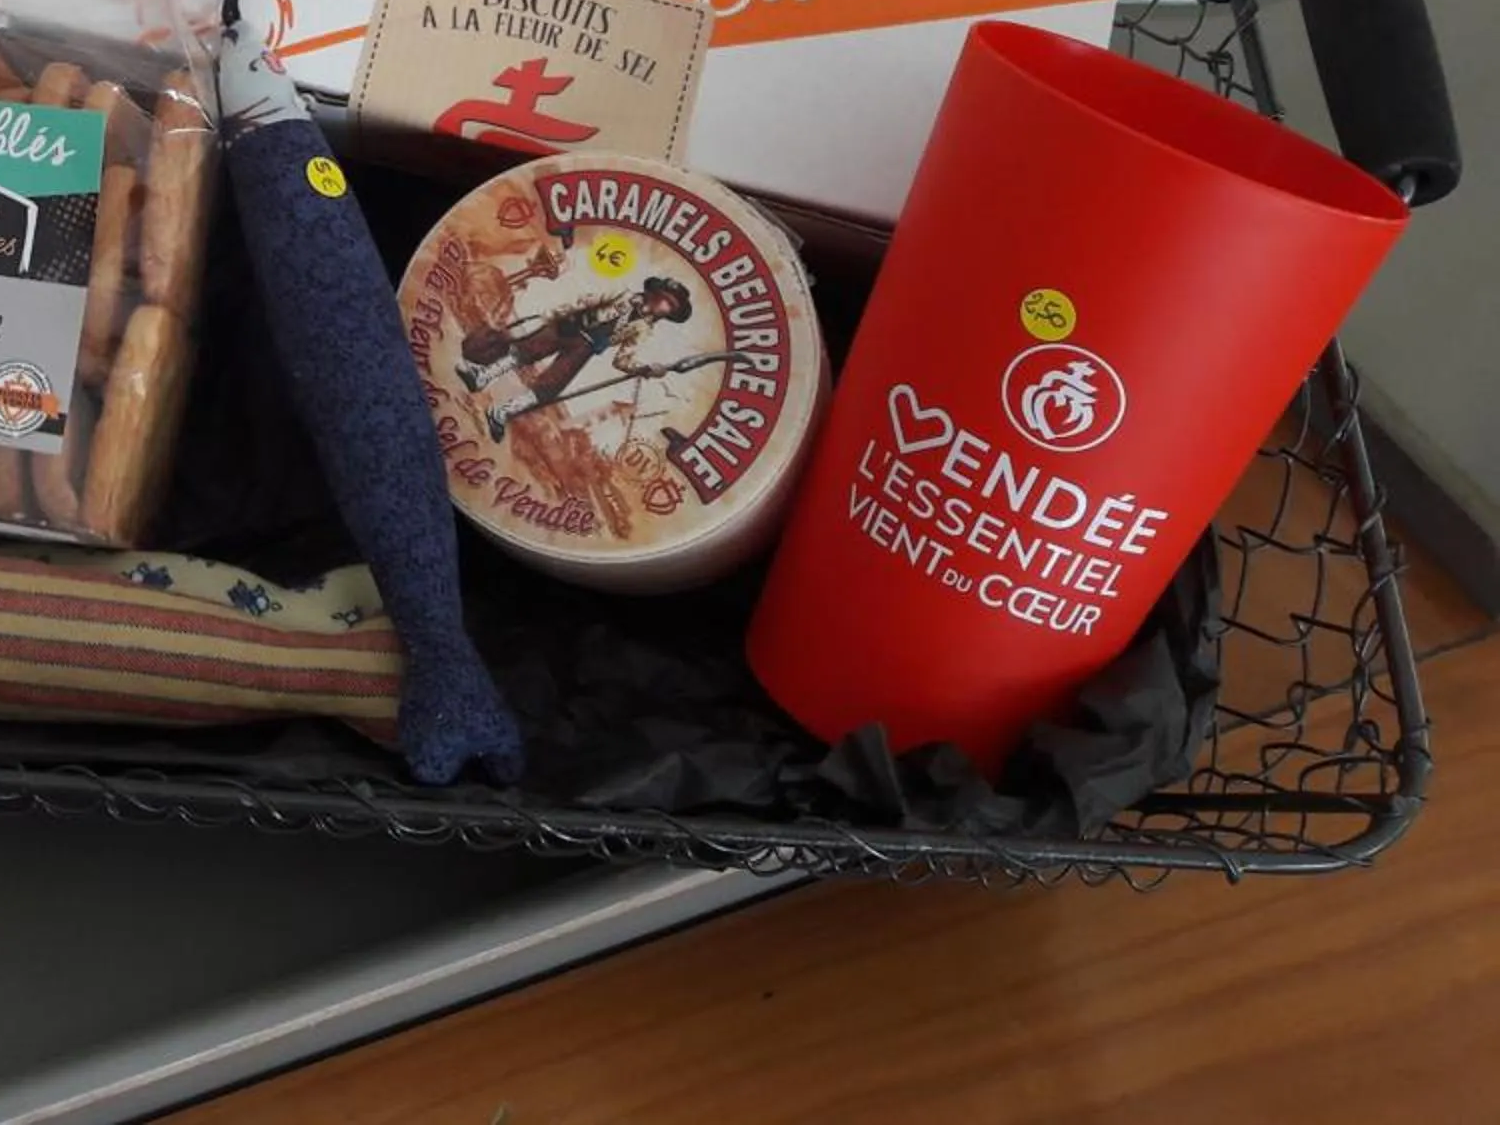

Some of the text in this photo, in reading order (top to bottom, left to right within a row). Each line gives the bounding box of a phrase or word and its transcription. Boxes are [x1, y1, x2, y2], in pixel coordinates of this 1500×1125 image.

[452, 5, 480, 32] LA
[494, 12, 563, 49] FLEUR
[573, 31, 609, 62] DE
[615, 48, 658, 85] SEL
[550, 180, 733, 264] CARAMELS
[709, 254, 781, 399] BEURRE
[847, 482, 1102, 636] VIENT DU CŒUR
[857, 439, 1124, 597] L'ESSENTIEL
